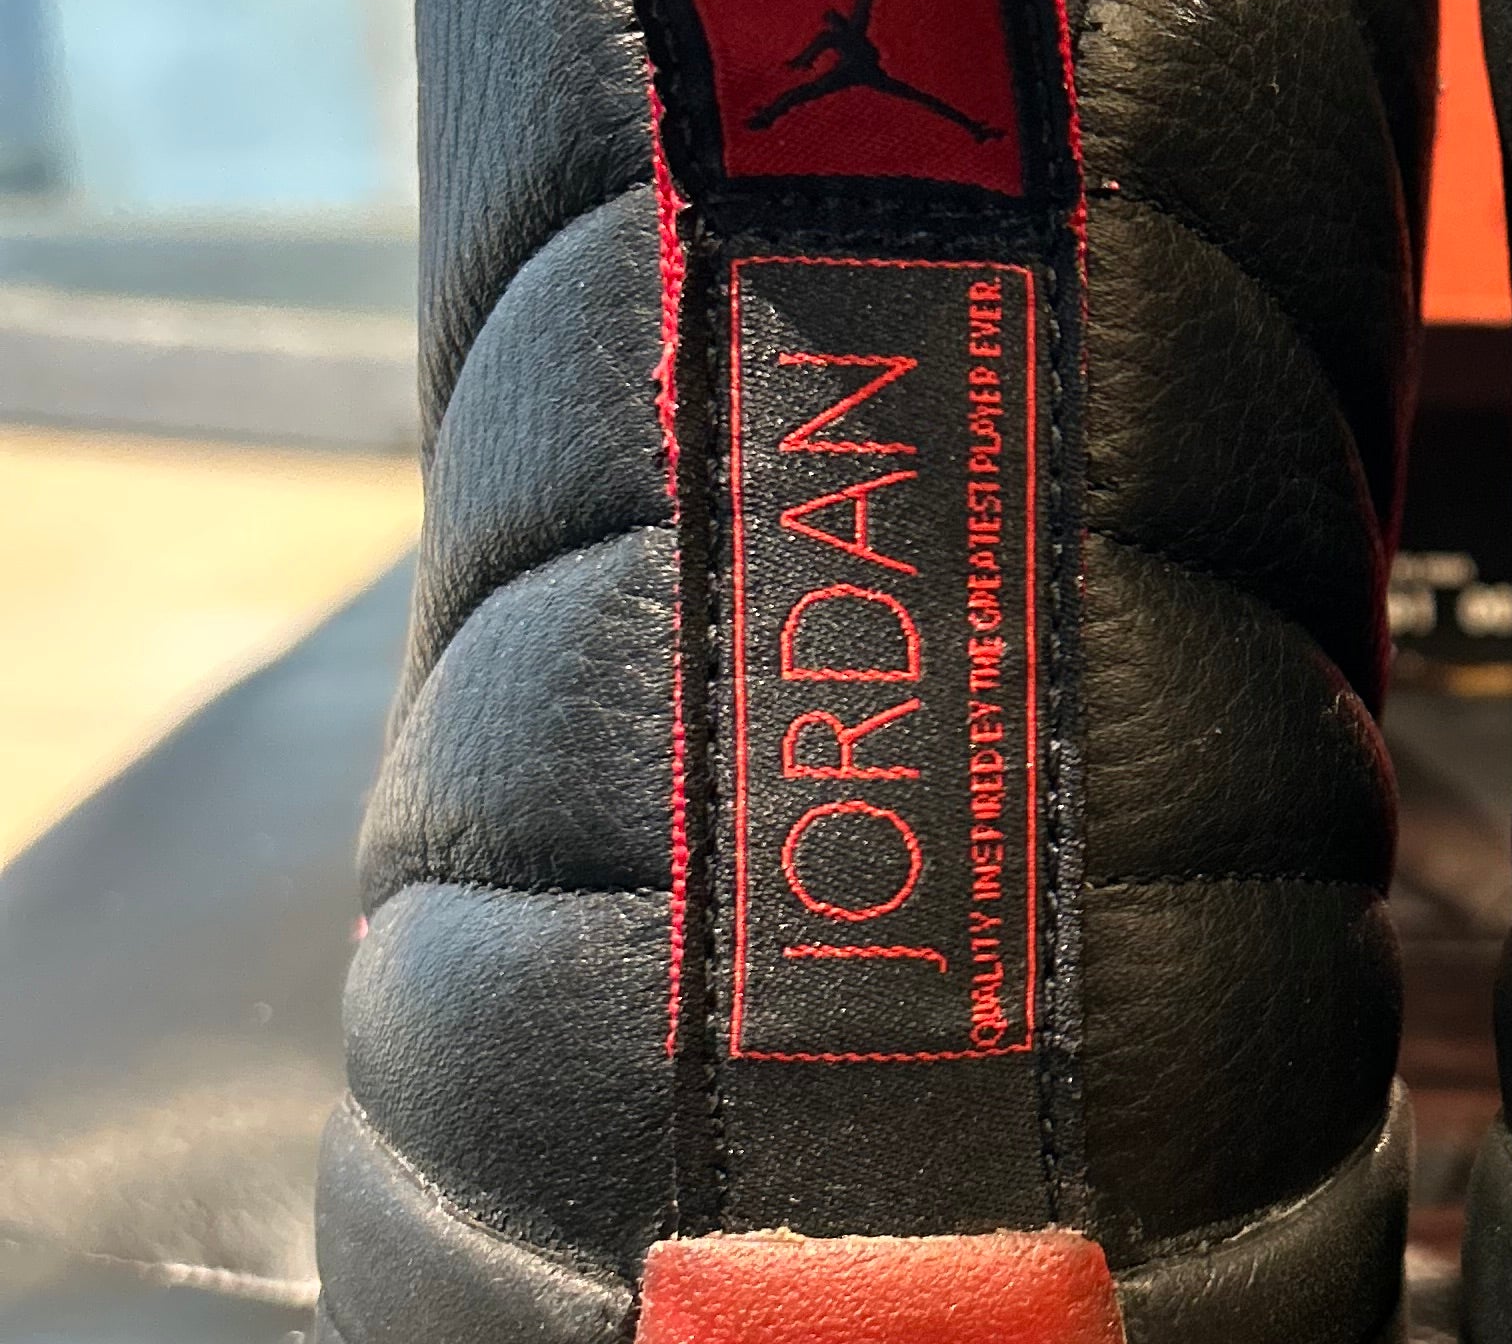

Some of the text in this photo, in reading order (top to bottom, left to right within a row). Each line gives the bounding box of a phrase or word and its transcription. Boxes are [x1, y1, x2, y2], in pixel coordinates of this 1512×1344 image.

[968, 364, 1003, 472] PLAYER
[968, 480, 1003, 630] GREATEST
[779, 351, 948, 973] JORDAN
[968, 635, 1006, 692] THE
[969, 748, 1005, 900] INSPIRED
[969, 911, 1008, 1046] QUALITY
